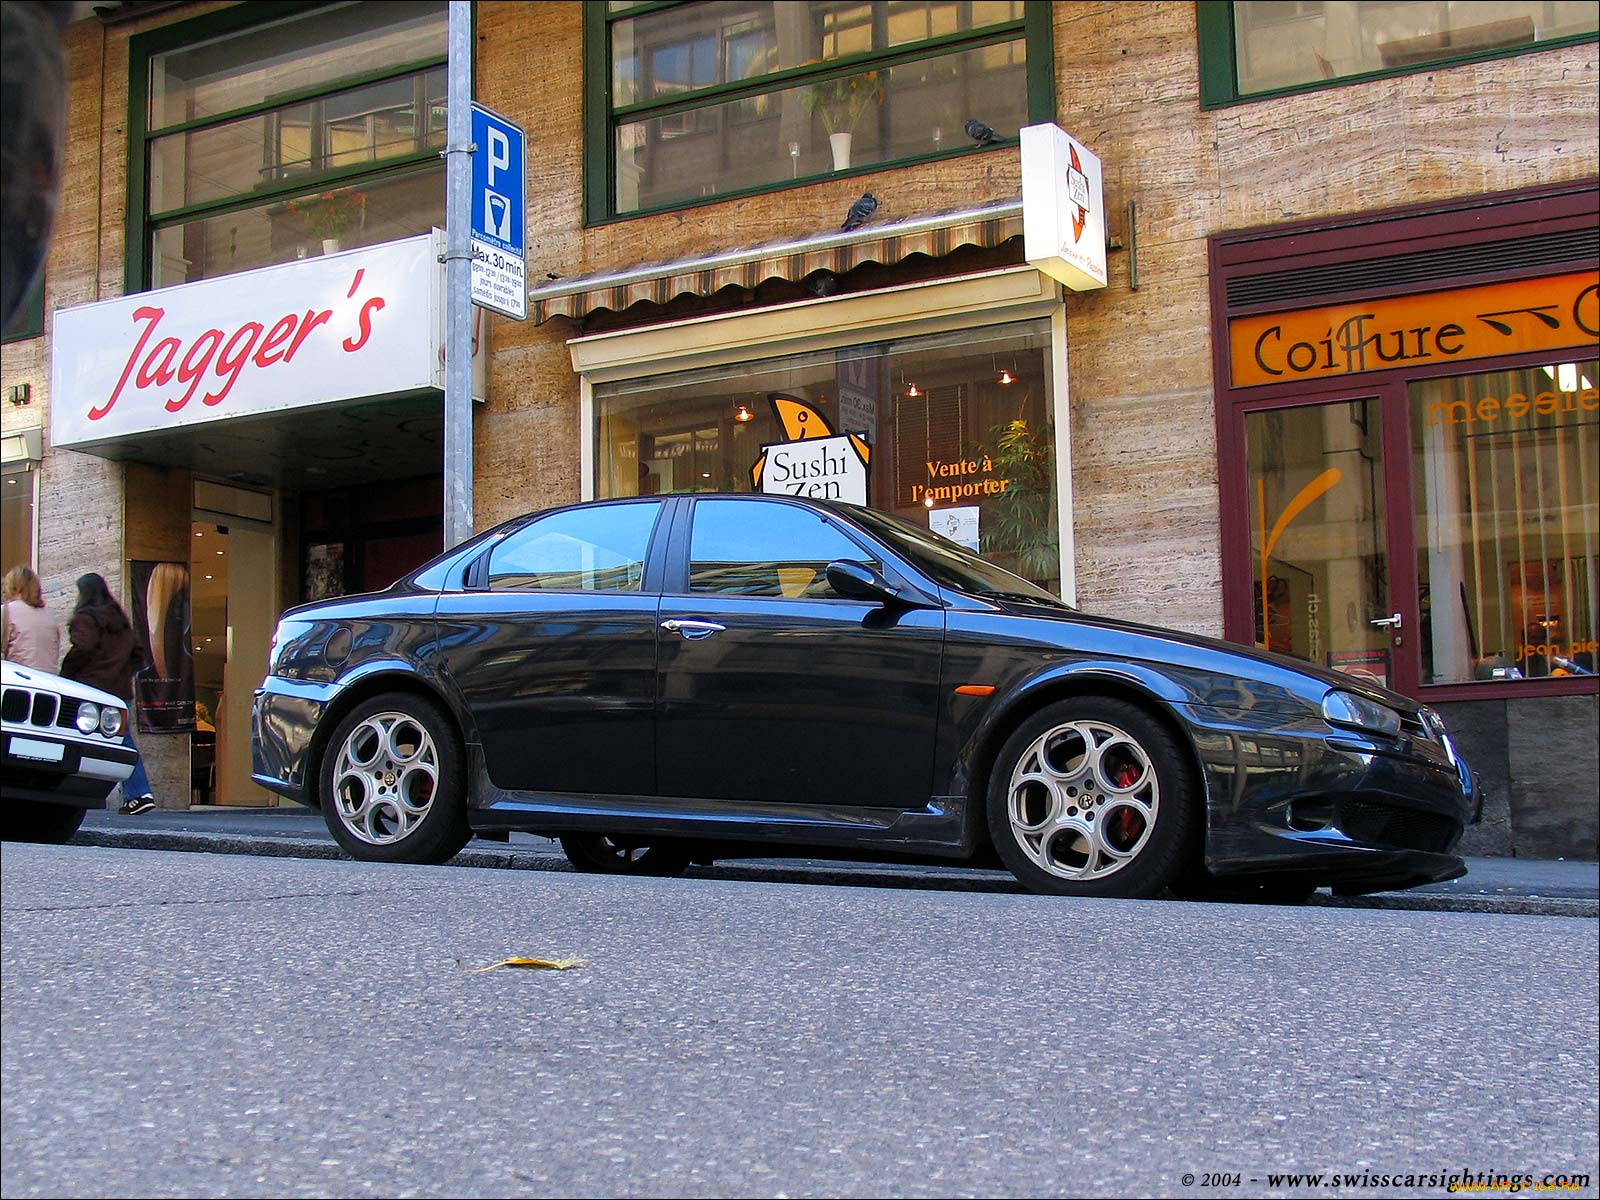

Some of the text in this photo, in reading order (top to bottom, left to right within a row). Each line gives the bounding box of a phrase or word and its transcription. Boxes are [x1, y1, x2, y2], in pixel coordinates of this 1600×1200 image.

[487, 125, 509, 187] P
[88, 268, 386, 420] Jagger's
[1254, 313, 1466, 376] Coiffure
[772, 445, 848, 482] Sushi
[926, 454, 993, 478] Vente à
[785, 481, 842, 500] Zen
[1515, 641, 1561, 662] jean
